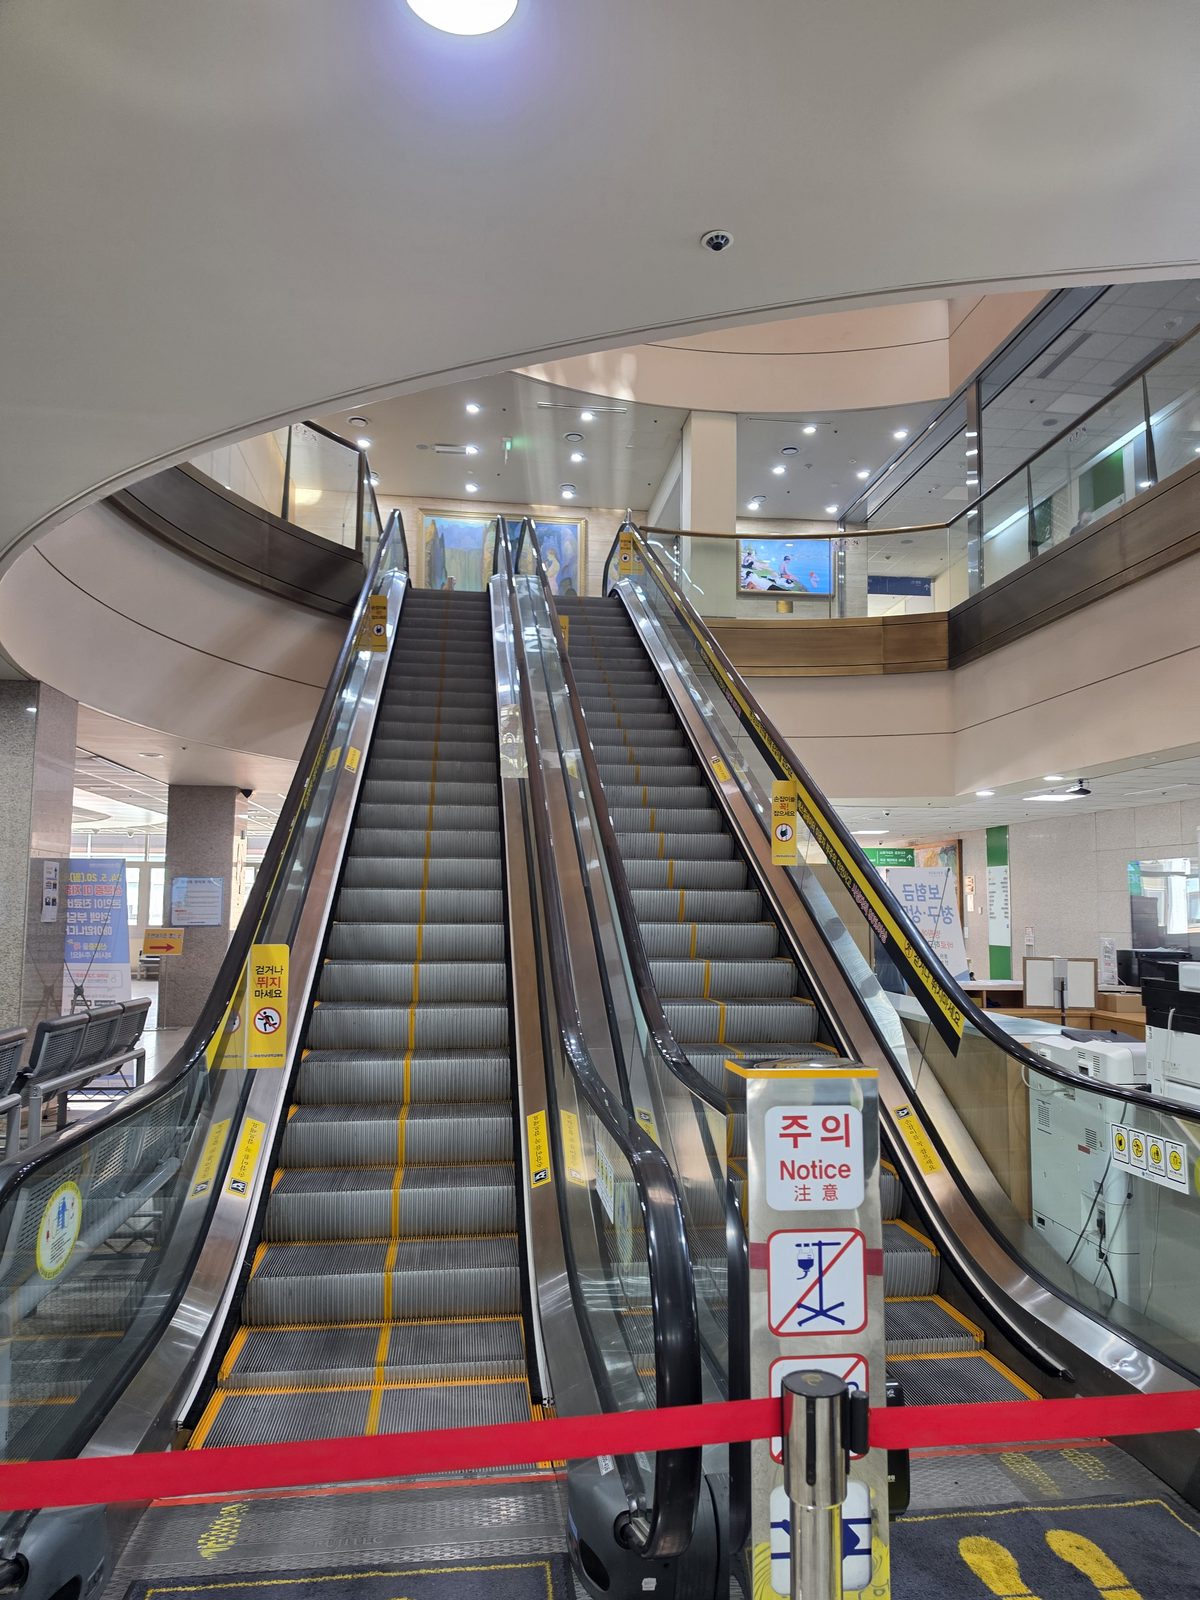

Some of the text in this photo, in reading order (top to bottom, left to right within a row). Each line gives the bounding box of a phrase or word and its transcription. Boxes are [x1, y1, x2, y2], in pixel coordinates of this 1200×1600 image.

[780, 803, 789, 811] 꼭!
[256, 966, 284, 975] 걷거나
[256, 976, 281, 988] 뛰지
[254, 989, 283, 998] 마세요
[780, 1159, 852, 1181] Notice
[794, 1183, 838, 1202] 注意
